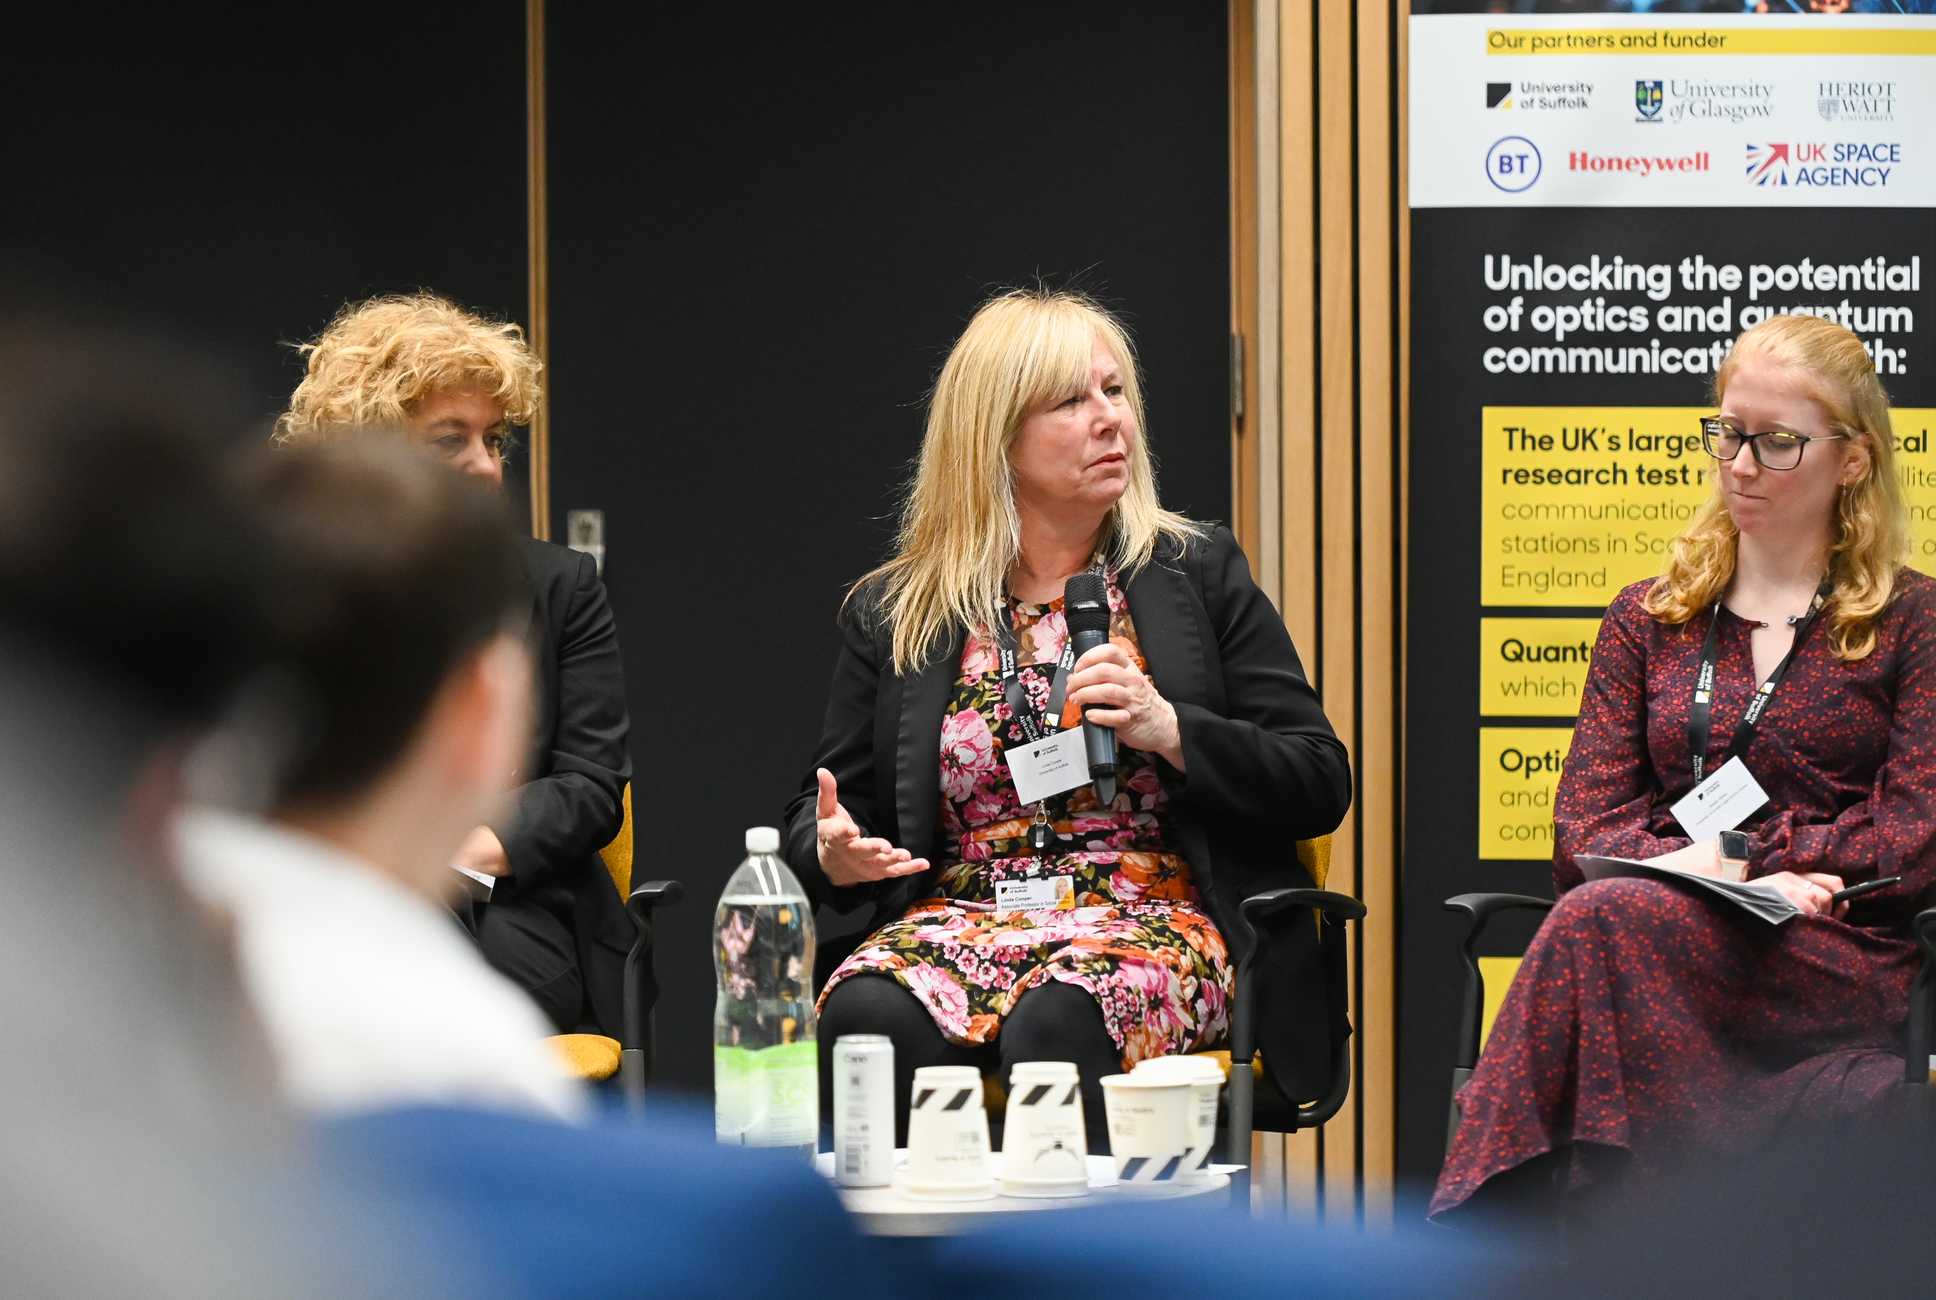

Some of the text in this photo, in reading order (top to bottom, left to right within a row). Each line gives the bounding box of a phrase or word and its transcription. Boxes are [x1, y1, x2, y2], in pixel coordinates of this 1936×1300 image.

[1489, 31, 1727, 53] Our partners and funder
[1520, 81, 1594, 96] University
[1670, 79, 1774, 99] University
[1818, 82, 1896, 97] HERIOT
[1520, 96, 1589, 109] of Suffolk
[1670, 99, 1774, 124] of Glasgow
[1568, 151, 1710, 176] Honeywell
[1796, 143, 1901, 162] UK SPACE
[1498, 154, 1530, 174] BT
[1795, 167, 1891, 187] AGENCY
[1483, 254, 1920, 300] Unlocking the potential
[1483, 297, 1526, 332] of
[1530, 299, 1649, 341] optics
[1656, 297, 1732, 332] and
[1502, 427, 1554, 451] The
[1562, 427, 1621, 451] UK's
[1502, 461, 1628, 486] research
[1636, 463, 1690, 486] test
[1501, 532, 1600, 555] stations
[1607, 532, 1628, 553] in
[1501, 564, 1607, 594] England
[1500, 675, 1577, 698] which
[1499, 786, 1550, 808] and
